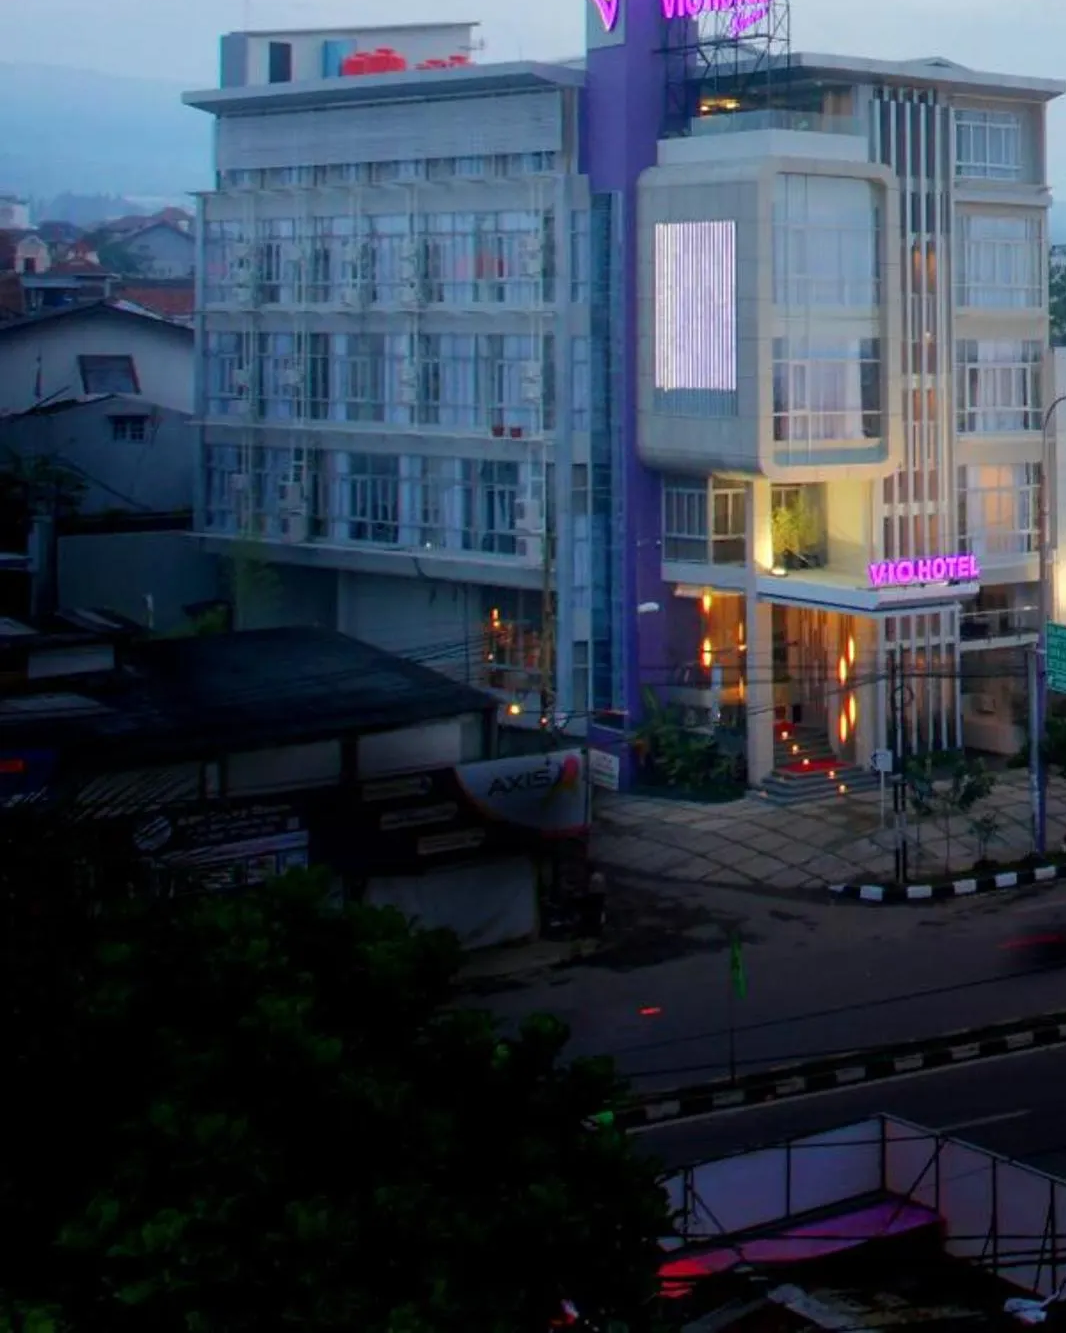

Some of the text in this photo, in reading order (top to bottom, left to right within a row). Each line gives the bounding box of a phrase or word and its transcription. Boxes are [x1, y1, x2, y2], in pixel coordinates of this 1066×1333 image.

[869, 554, 979, 587] VIO HOTEL
[487, 770, 552, 797] AXIS
